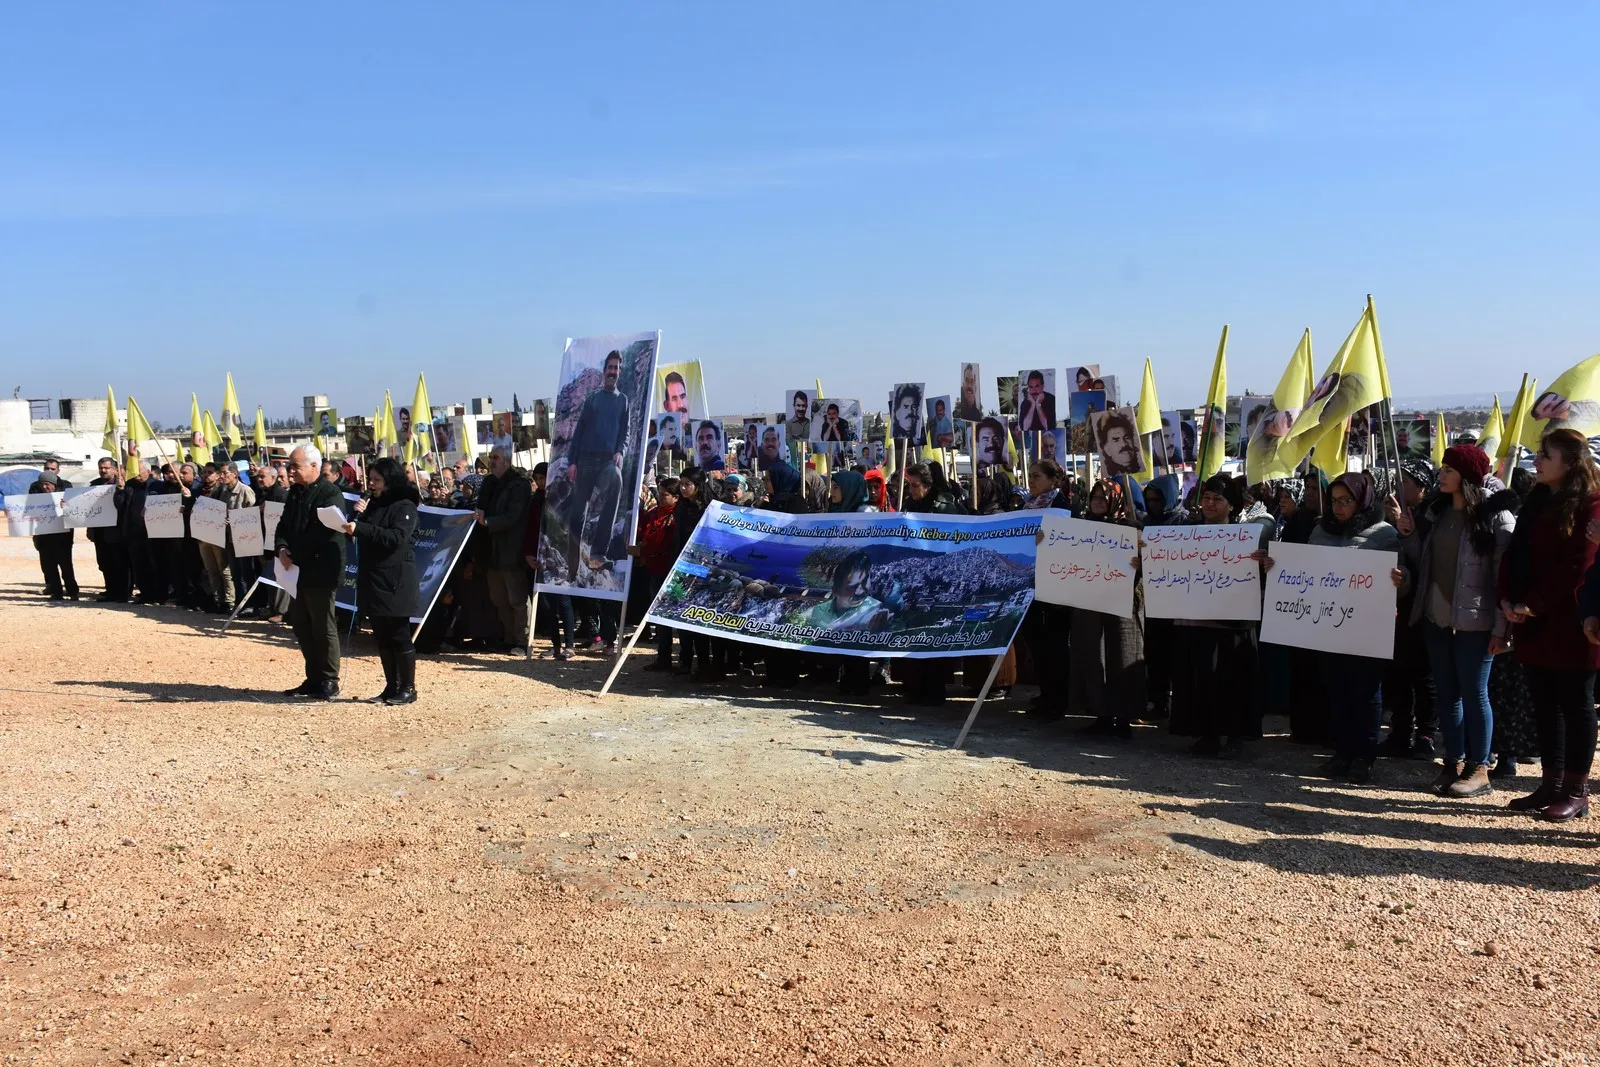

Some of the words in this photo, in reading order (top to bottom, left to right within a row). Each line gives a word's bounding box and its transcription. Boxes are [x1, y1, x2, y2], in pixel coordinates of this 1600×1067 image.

[717, 513, 753, 531] Projeya
[754, 521, 786, 535] Netewa
[787, 525, 839, 538] Demokratik
[918, 527, 950, 541] Rêber
[951, 529, 971, 544] Apo
[982, 528, 1006, 540] were
[1147, 529, 1183, 543] وشرق
[1183, 528, 1212, 542] شمال
[1213, 527, 1253, 542] مقاومة
[1097, 533, 1134, 550] مقاومة
[1200, 548, 1220, 565] هي
[1216, 571, 1256, 588] مشروع
[1320, 572, 1345, 588] rêber
[1349, 574, 1373, 589] APO
[681, 605, 716, 623] APO
[713, 611, 747, 629] القائد
[1333, 606, 1354, 628] ye
[745, 617, 777, 633] بحرية
[791, 626, 861, 643] الديمقراطية
[888, 632, 934, 647] مشروع
[933, 632, 975, 647] يكتمل
[973, 630, 993, 645] لن
